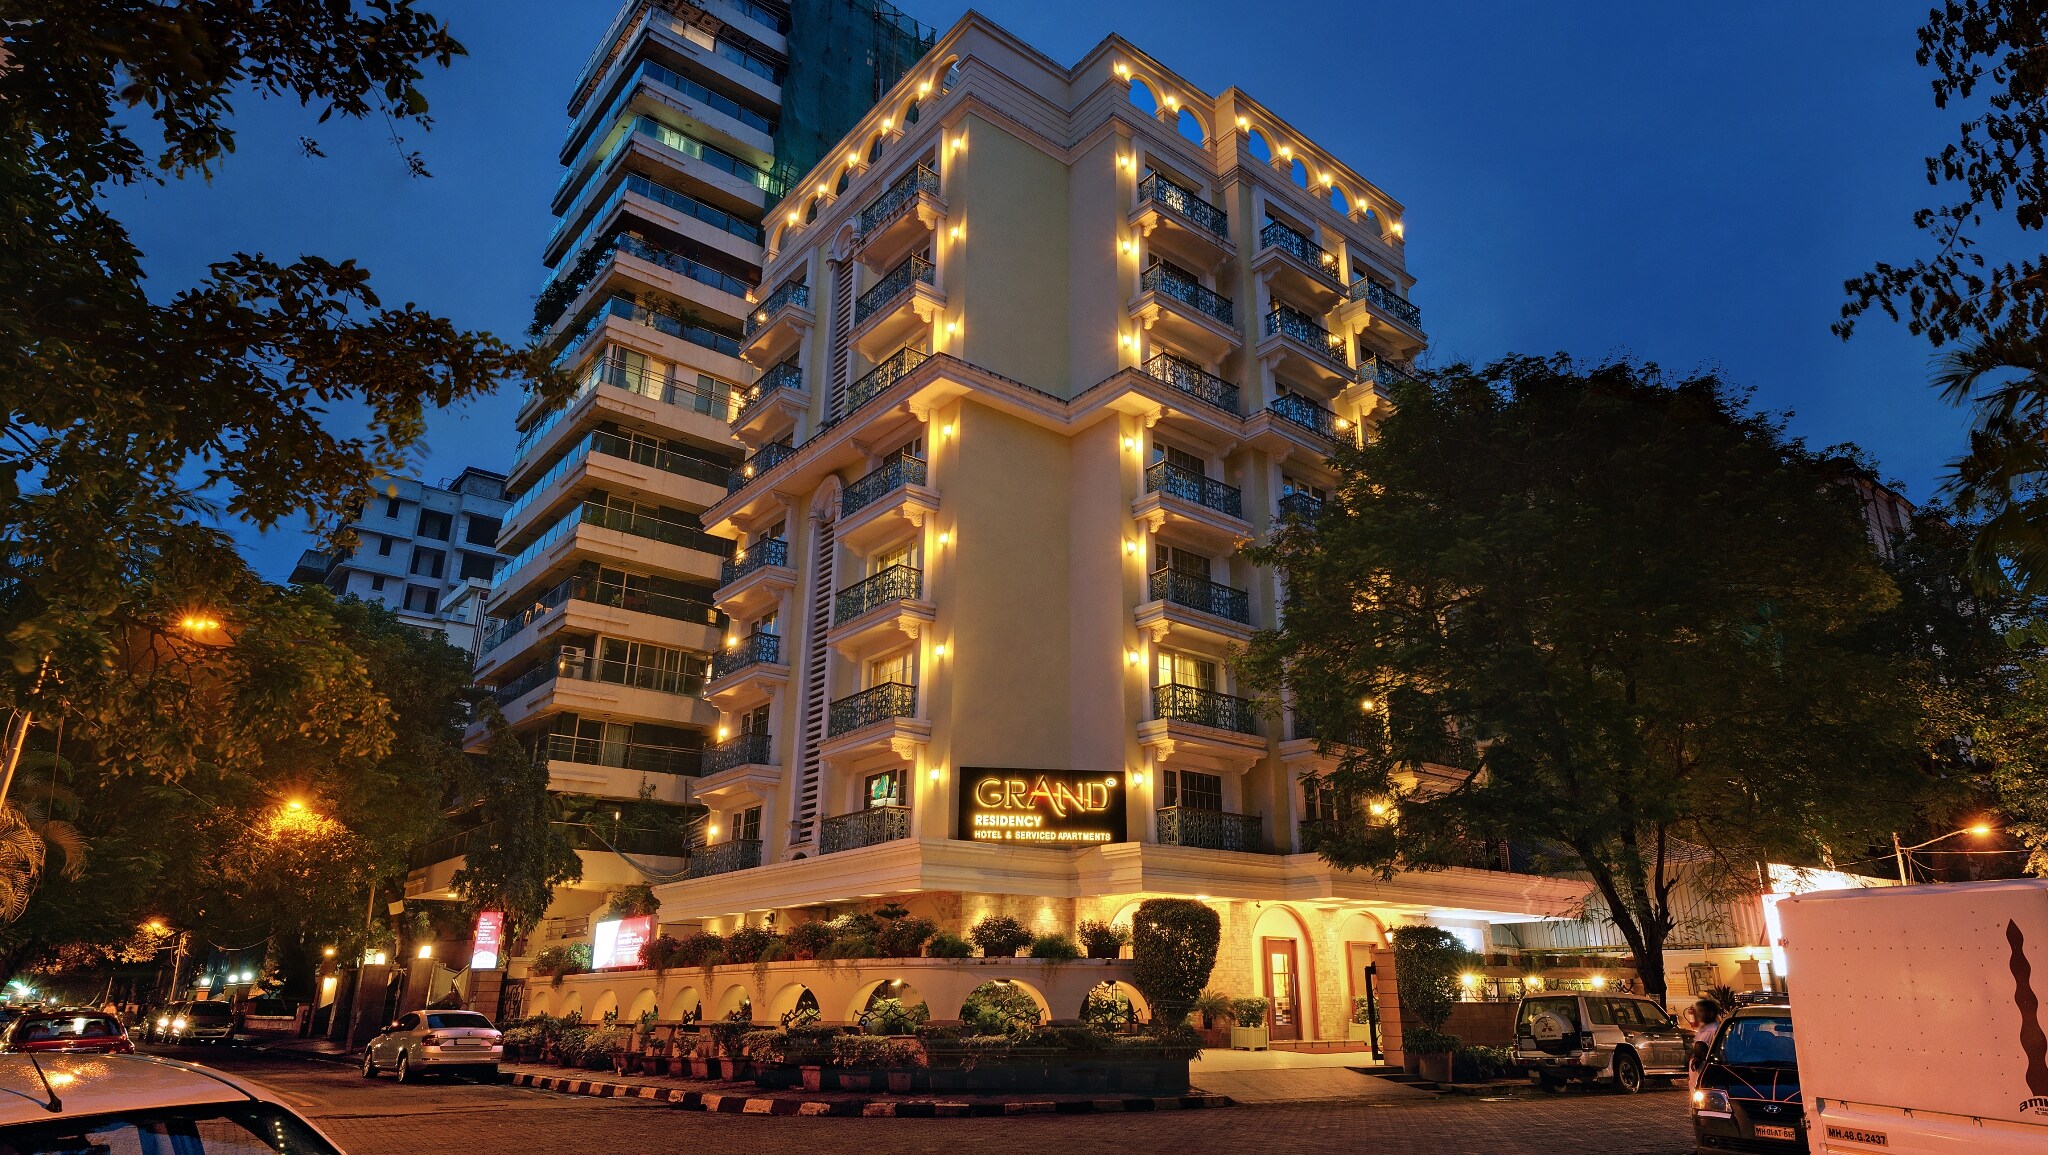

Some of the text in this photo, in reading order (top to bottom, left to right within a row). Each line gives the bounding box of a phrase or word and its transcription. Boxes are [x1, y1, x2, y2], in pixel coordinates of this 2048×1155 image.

[976, 774, 1111, 817] GRAND
[975, 815, 1042, 827] RESIDENCY
[975, 830, 1111, 841] HOTEL & SERVICED APARTMENTS
[1828, 1128, 1886, 1144] MH.48.G.2437
